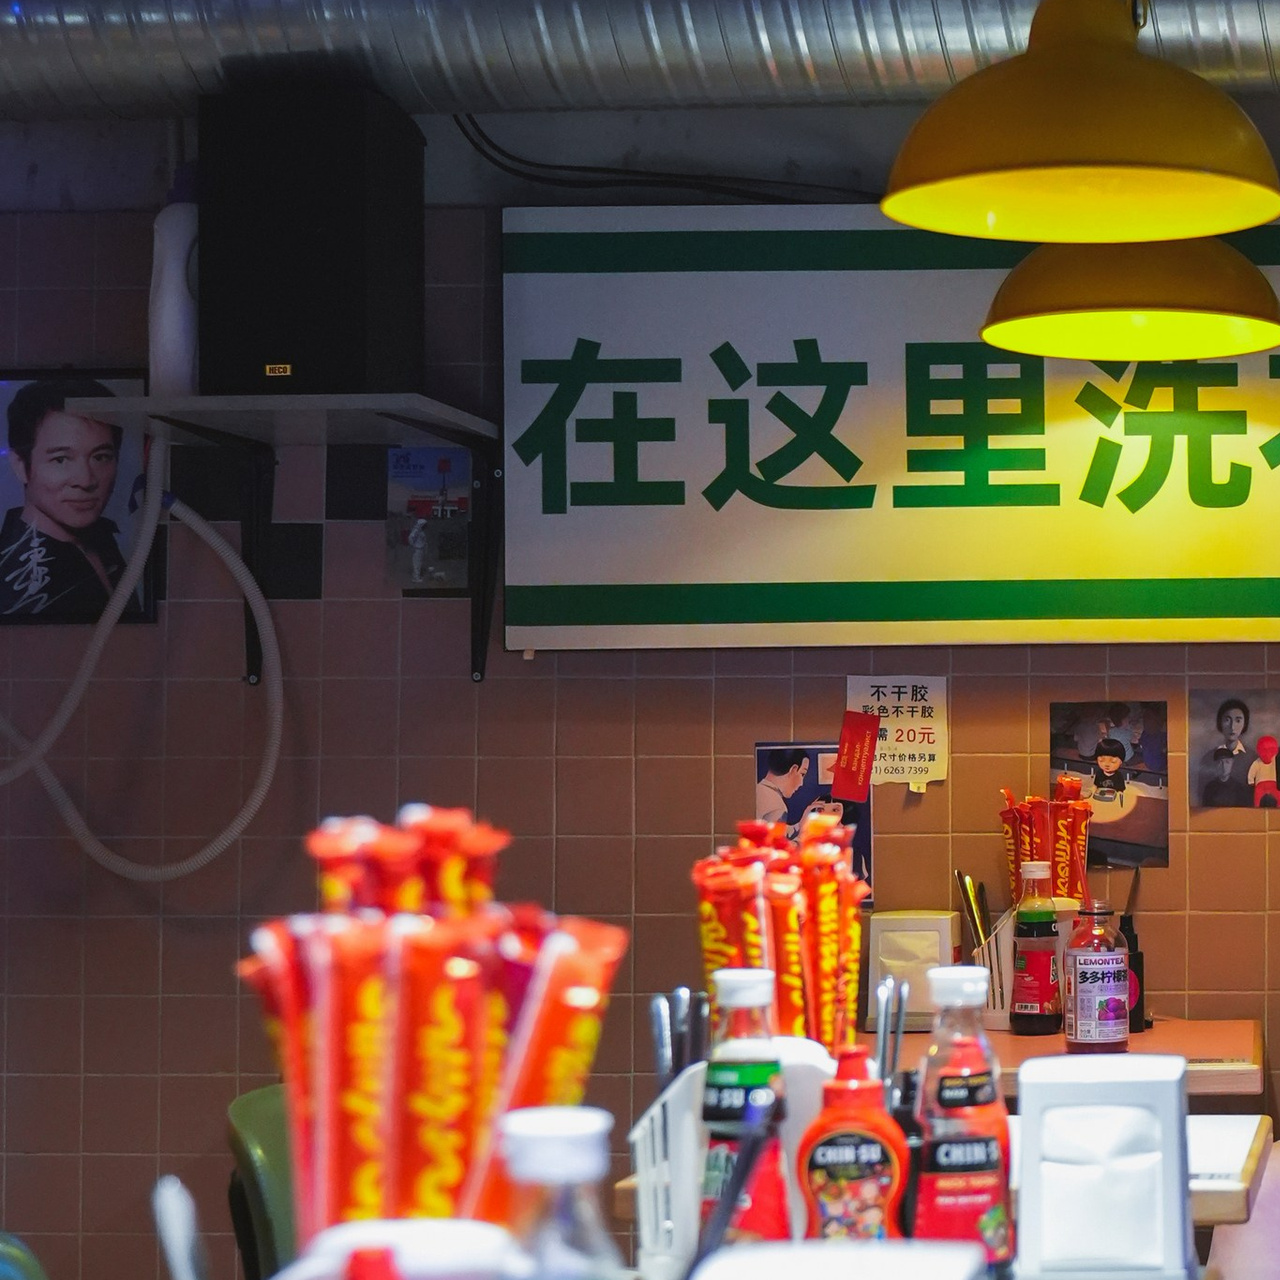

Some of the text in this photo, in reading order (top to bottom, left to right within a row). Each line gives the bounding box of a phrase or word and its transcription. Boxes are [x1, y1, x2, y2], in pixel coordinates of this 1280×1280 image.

[870, 684, 929, 702] 不干胶
[861, 704, 935, 719] 彩色不干胶
[894, 727, 936, 745] 20元
[884, 766, 905, 775] 6263
[908, 766, 929, 775] 7399
[1078, 957, 1124, 966] LEMONTEA
